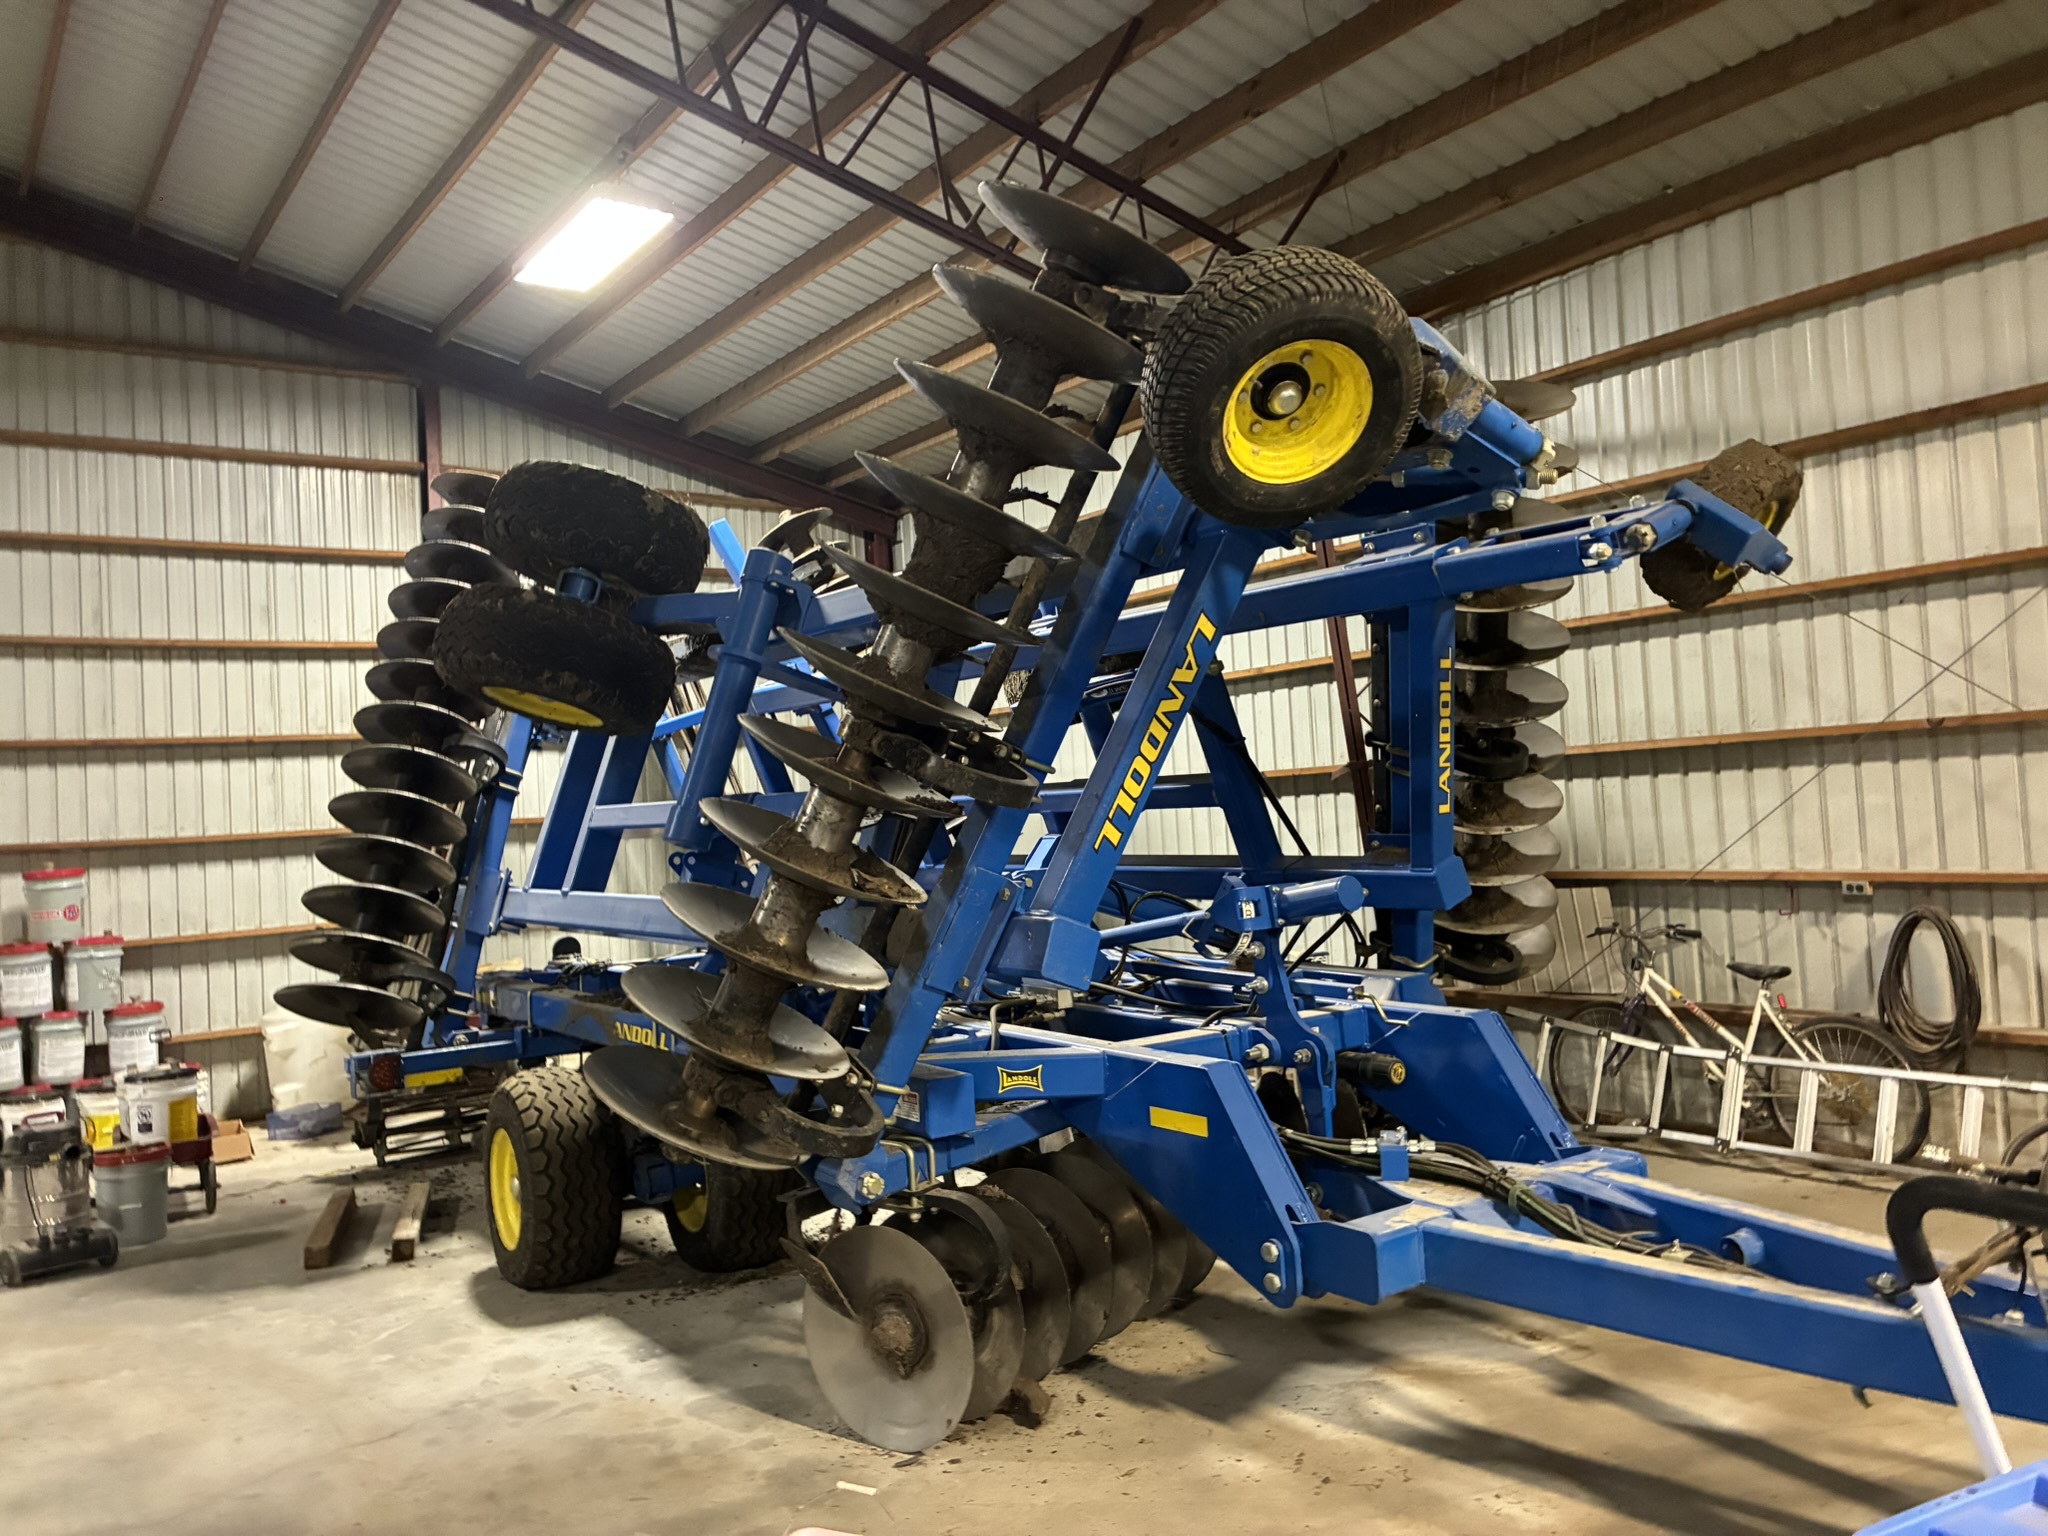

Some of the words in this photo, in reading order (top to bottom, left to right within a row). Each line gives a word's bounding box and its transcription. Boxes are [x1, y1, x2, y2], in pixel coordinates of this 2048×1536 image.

[1094, 610, 1217, 852] LANDOLL
[1438, 646, 1452, 815] LANDOLL
[1002, 1071, 1038, 1087] LANDOLL
